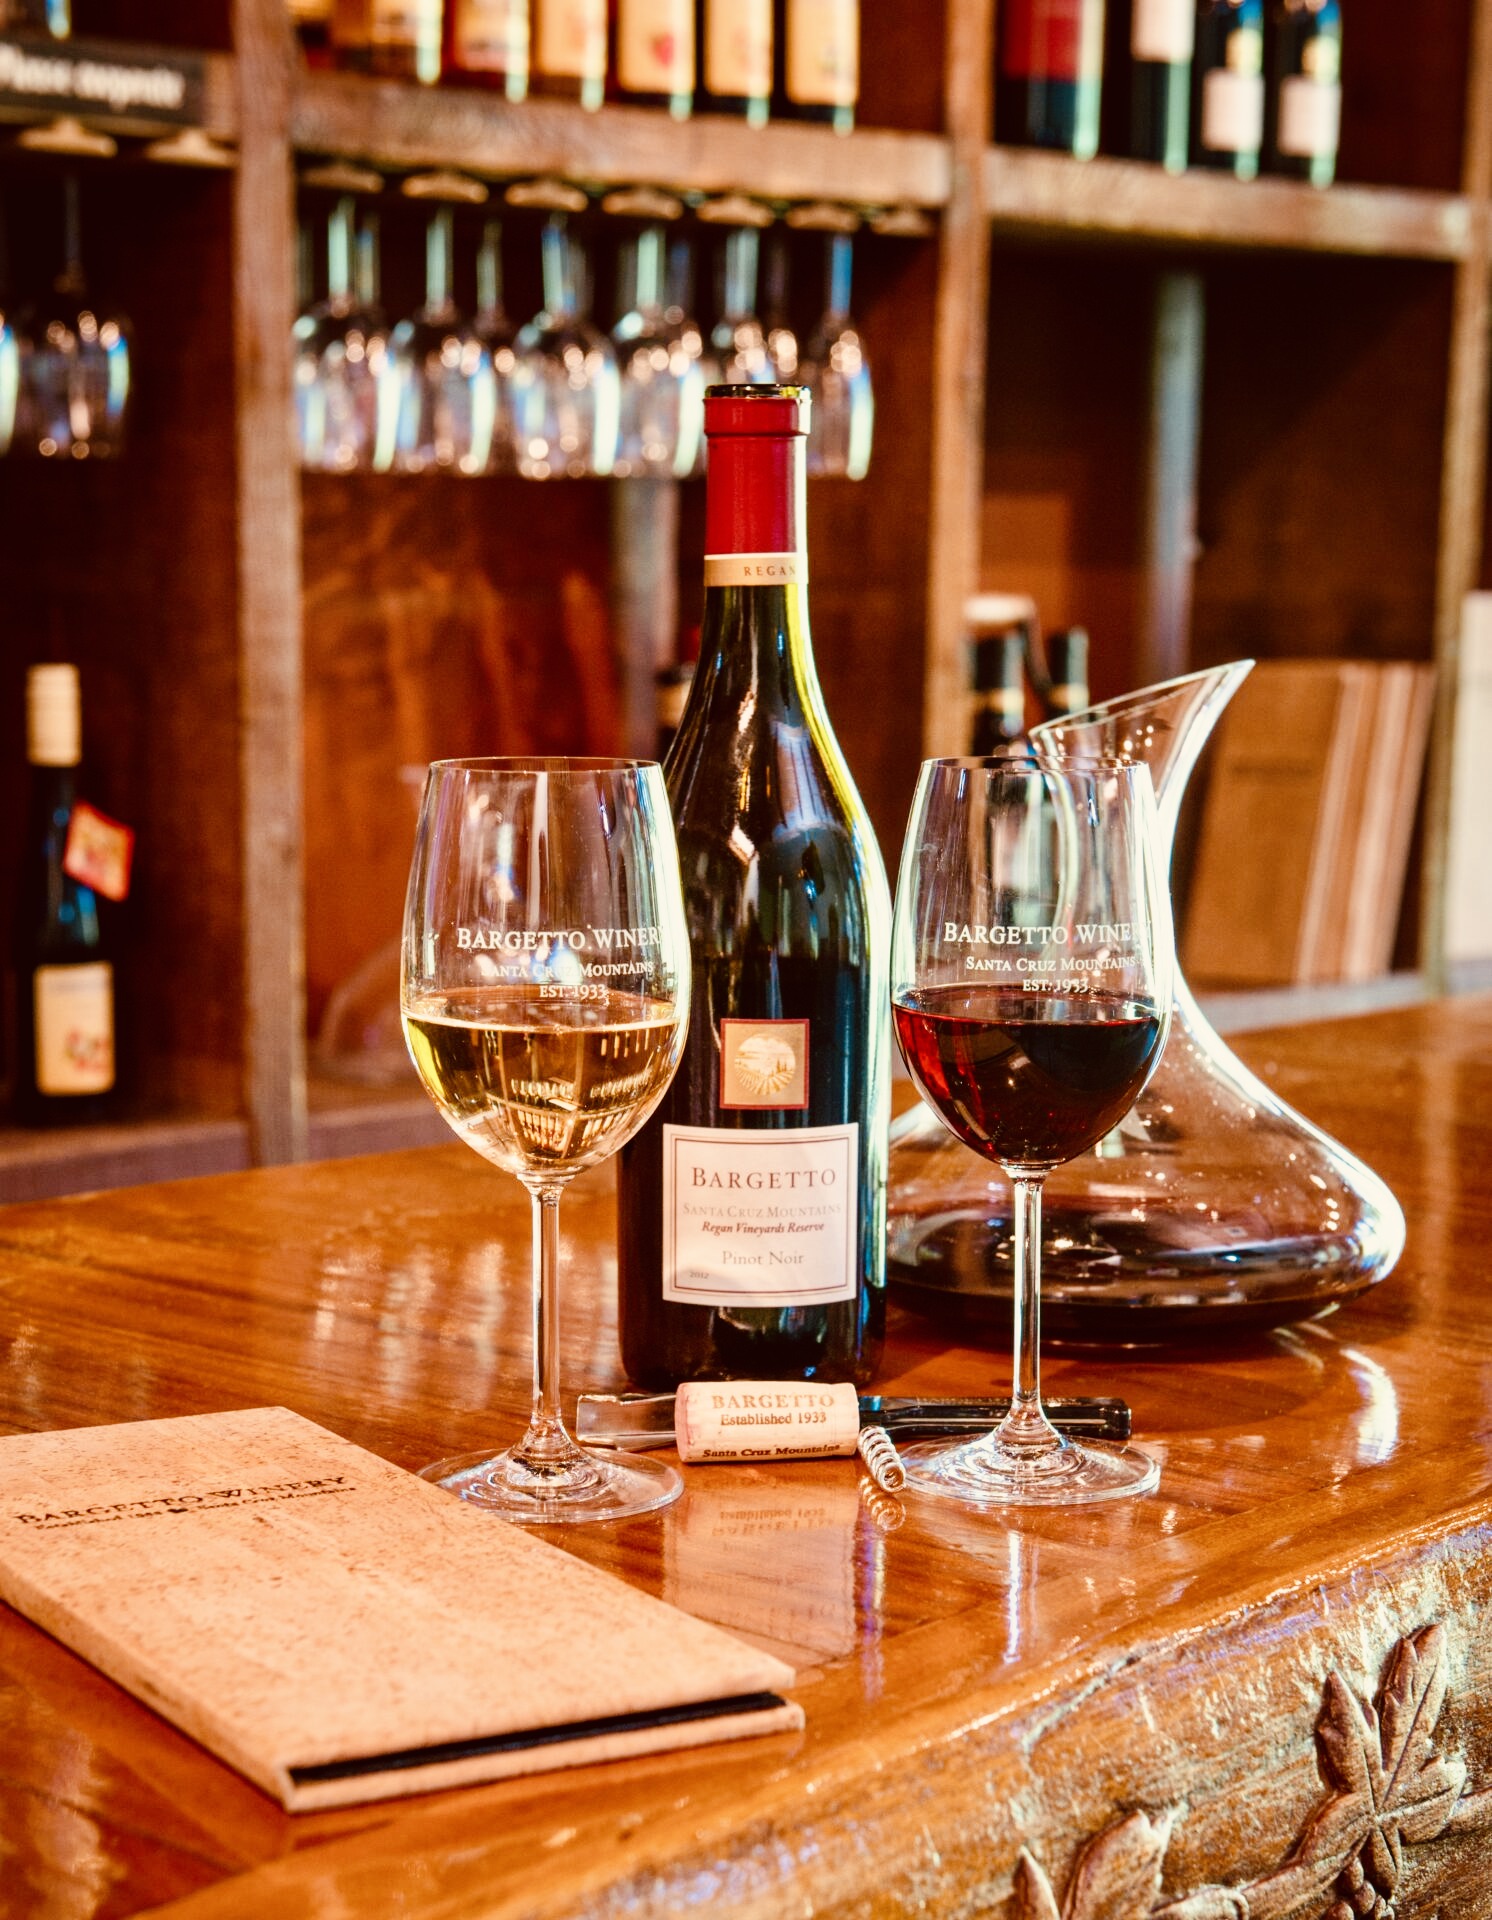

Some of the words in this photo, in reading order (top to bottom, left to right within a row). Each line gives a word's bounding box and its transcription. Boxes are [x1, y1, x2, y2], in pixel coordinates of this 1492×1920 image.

[456, 927, 587, 951] BARGETTO
[943, 921, 1068, 945] BARGETTO
[1076, 922, 1150, 944] WINE
[580, 961, 655, 978] MOUNTAINS
[966, 956, 1012, 971] SANTA
[1016, 957, 1056, 971] CRUZ
[1060, 957, 1136, 971] MOUNTAINS
[574, 984, 607, 1000] 1933
[1054, 978, 1089, 993] 1933
[692, 1167, 836, 1190] BARGETTO
[683, 1203, 724, 1216] SANTA
[727, 1206, 764, 1218] CRUZ
[767, 1204, 842, 1218] MOUNTAINS
[702, 1221, 733, 1236] Regan
[736, 1222, 785, 1237] Vineyards
[788, 1222, 825, 1233] Reserve
[722, 1251, 764, 1265] Pinot
[769, 1251, 805, 1265] Noir
[689, 1271, 710, 1279] 2012
[712, 1395, 835, 1409] BARGETTO
[720, 1413, 792, 1426] Established
[798, 1411, 827, 1424] 1933
[702, 1449, 737, 1457] Santa
[775, 1444, 840, 1455] Mountains
[206, 1476, 346, 1498] WINERY
